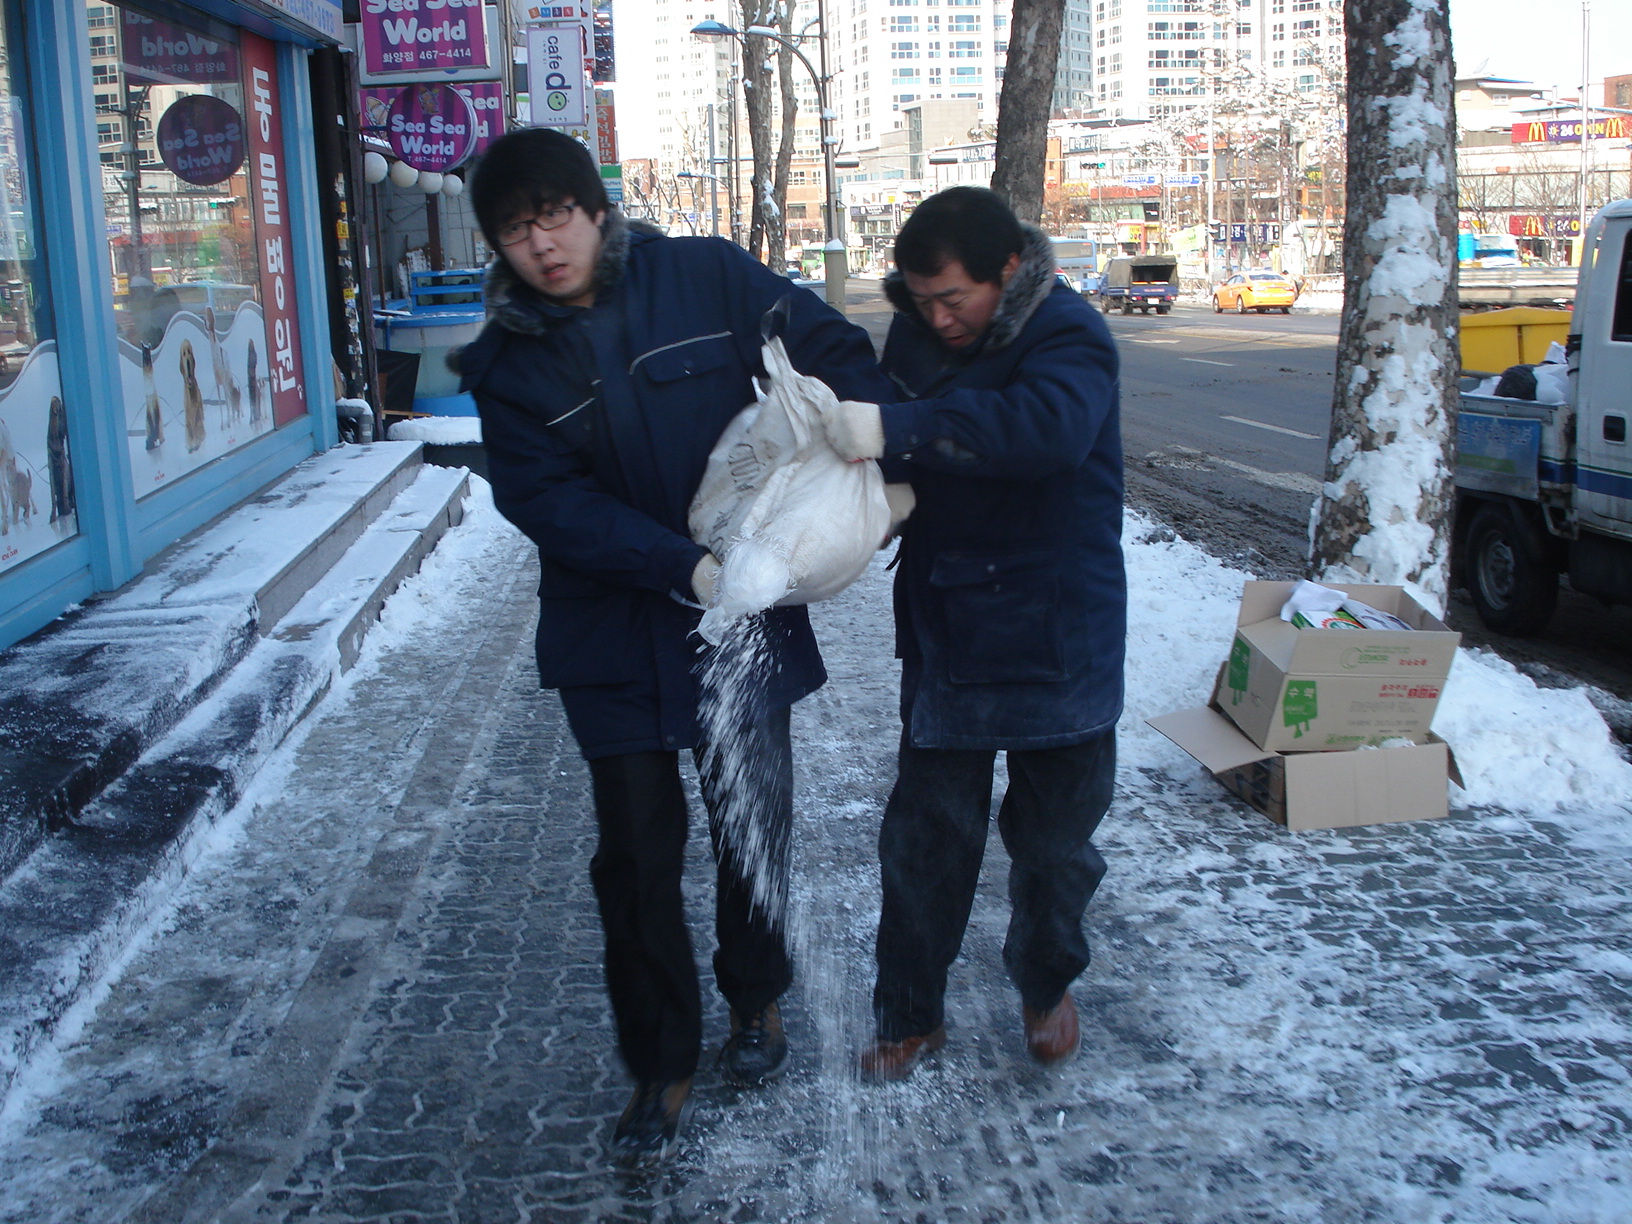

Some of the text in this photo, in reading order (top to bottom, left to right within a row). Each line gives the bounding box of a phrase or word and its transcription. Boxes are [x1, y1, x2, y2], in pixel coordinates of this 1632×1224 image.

[382, 17, 467, 45] World
[382, 48, 472, 64] 화양점 467-4414
[547, 35, 562, 70] cafe
[391, 114, 426, 133] Sea
[429, 115, 466, 135] Sea
[1560, 124, 1574, 137] 24
[1574, 122, 1605, 136] ON
[400, 135, 455, 155] World
[251, 66, 297, 392] 동물병원
